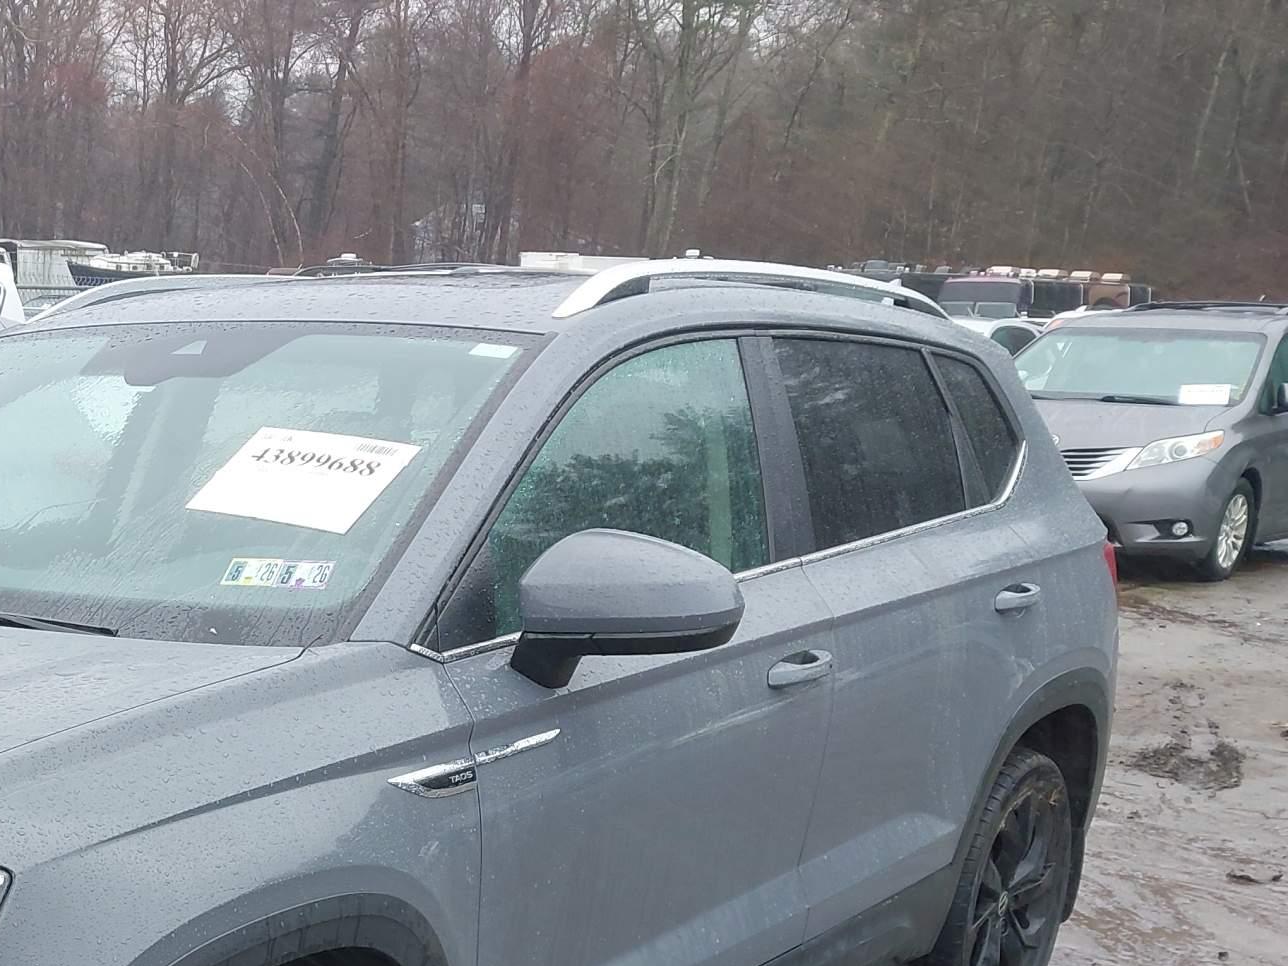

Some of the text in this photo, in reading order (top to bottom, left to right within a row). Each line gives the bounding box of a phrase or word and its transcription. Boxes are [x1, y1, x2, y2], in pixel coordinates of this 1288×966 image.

[252, 447, 381, 477] 43899688
[232, 563, 279, 582] 5 26
[280, 564, 331, 585] 5 26
[449, 770, 474, 784] TAOS
